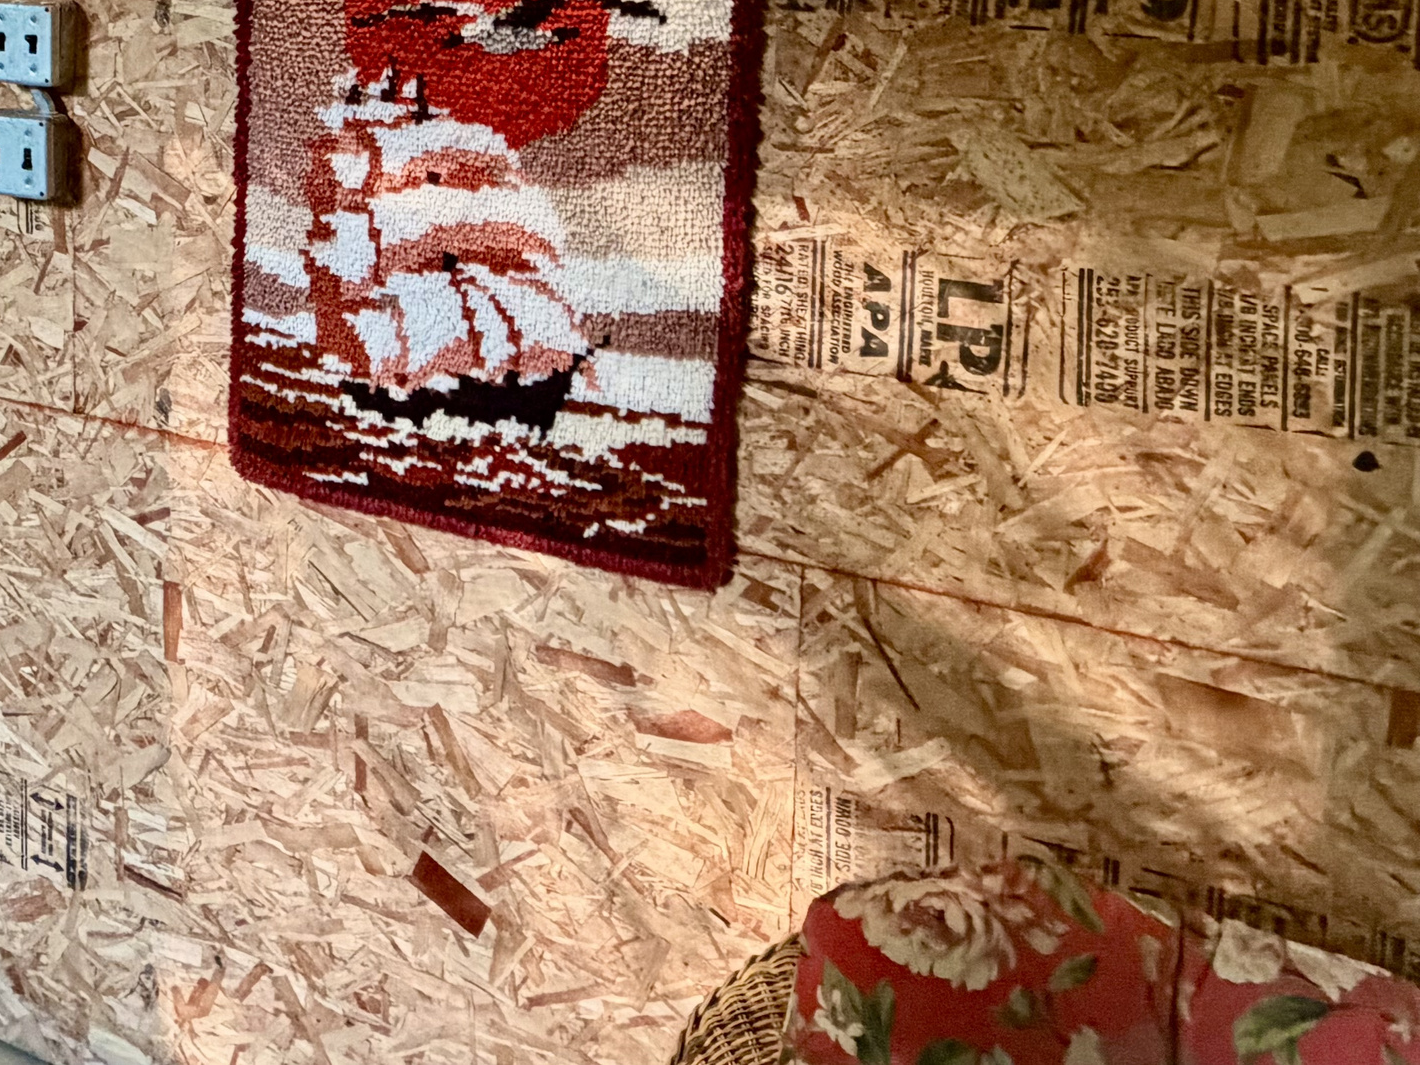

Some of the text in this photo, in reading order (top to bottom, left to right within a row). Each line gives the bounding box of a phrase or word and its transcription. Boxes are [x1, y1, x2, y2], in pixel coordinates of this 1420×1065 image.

[761, 279, 773, 300] FOR
[775, 243, 795, 295] 24/16
[843, 263, 855, 282] THE
[1126, 275, 1142, 296] APA
[794, 244, 810, 361] RATED SHEATHING
[828, 250, 844, 365] WOOD ASSOCIATION
[860, 262, 892, 357] APA
[778, 328, 792, 358] INCH
[937, 278, 1004, 376] LP
[1156, 322, 1177, 360] LADO
[1178, 287, 1202, 413] THIS SIDE DOWN
[1260, 305, 1280, 409] SPACE PANELS
[1154, 365, 1176, 411] ABAJO
[1214, 373, 1234, 417] EDGES
[1238, 381, 1256, 417] ENDS
[809, 789, 824, 829] EDGES
[808, 831, 823, 847] AT
[834, 796, 852, 873] SIDE DOWN
[808, 849, 824, 878] INCH
